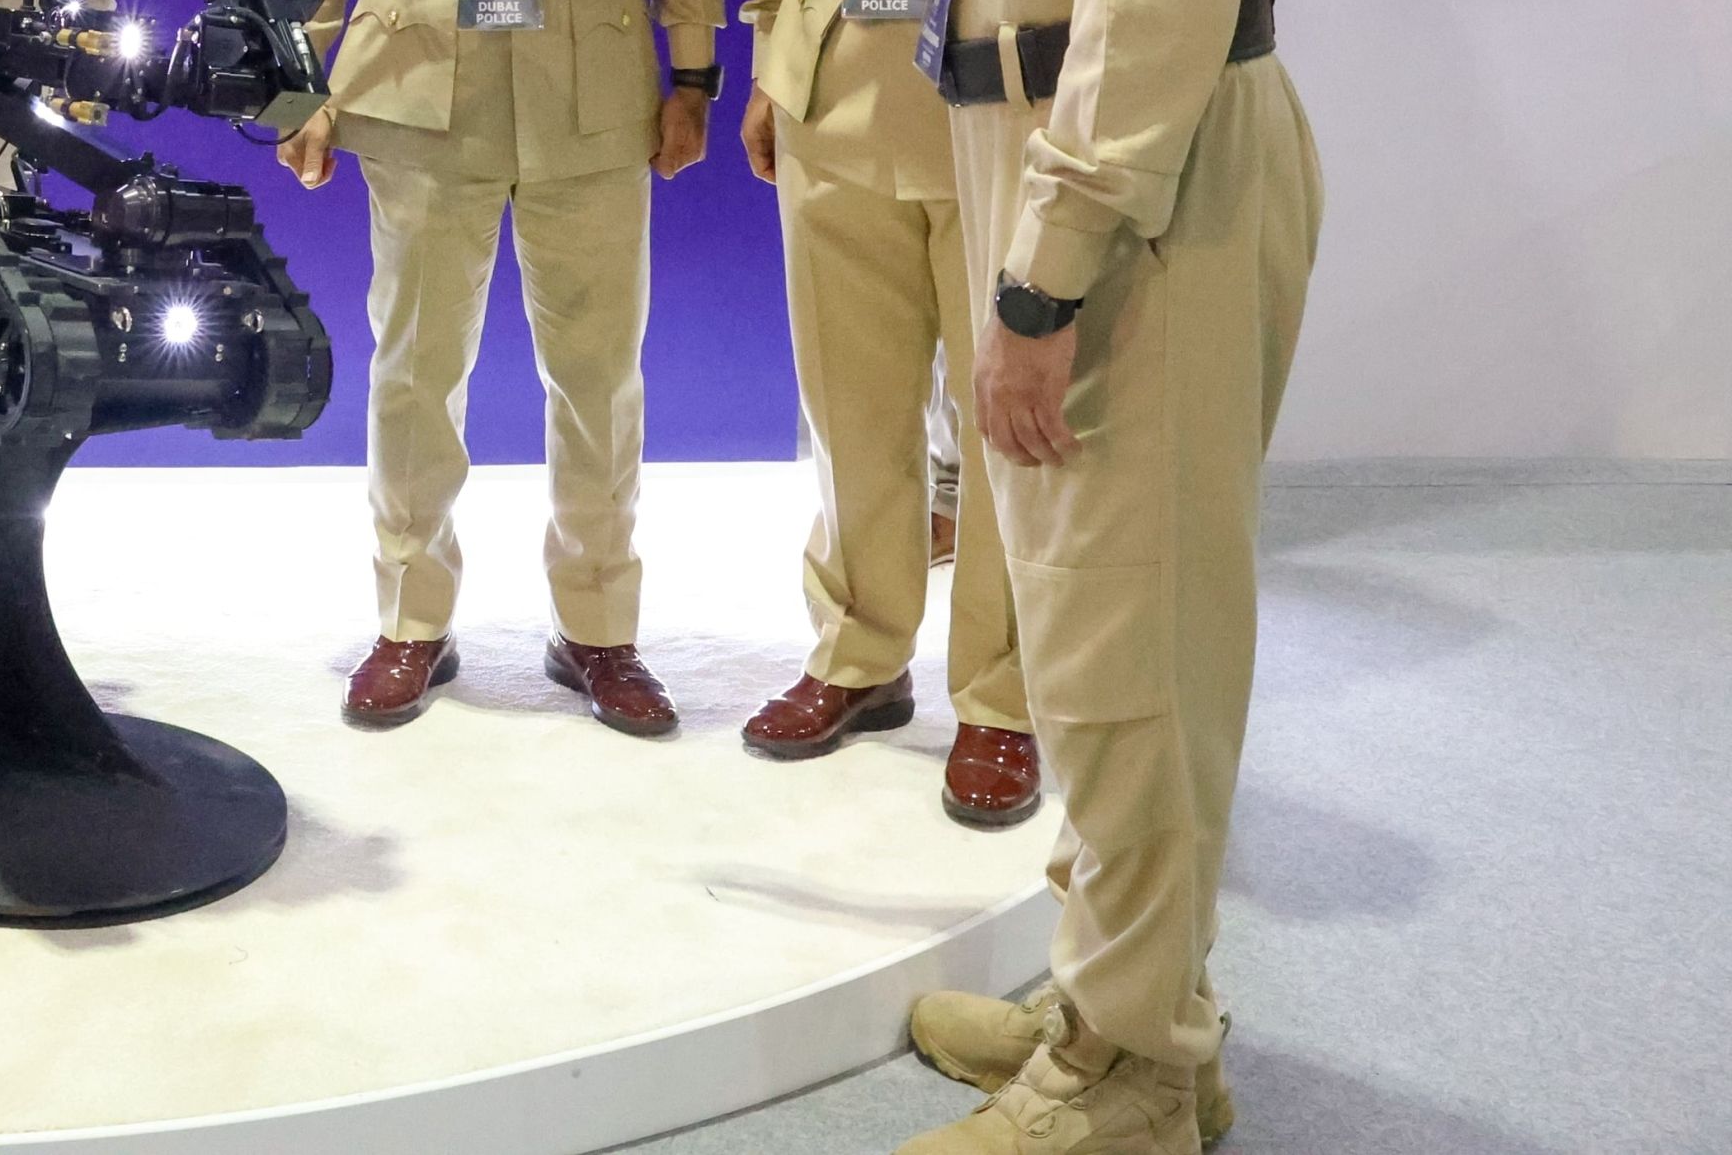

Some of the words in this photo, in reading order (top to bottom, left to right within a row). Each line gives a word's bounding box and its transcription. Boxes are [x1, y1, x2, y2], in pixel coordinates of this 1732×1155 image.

[478, 1, 520, 12] DUBAI
[861, 0, 909, 11] POLICE
[476, 12, 523, 24] POLICE
